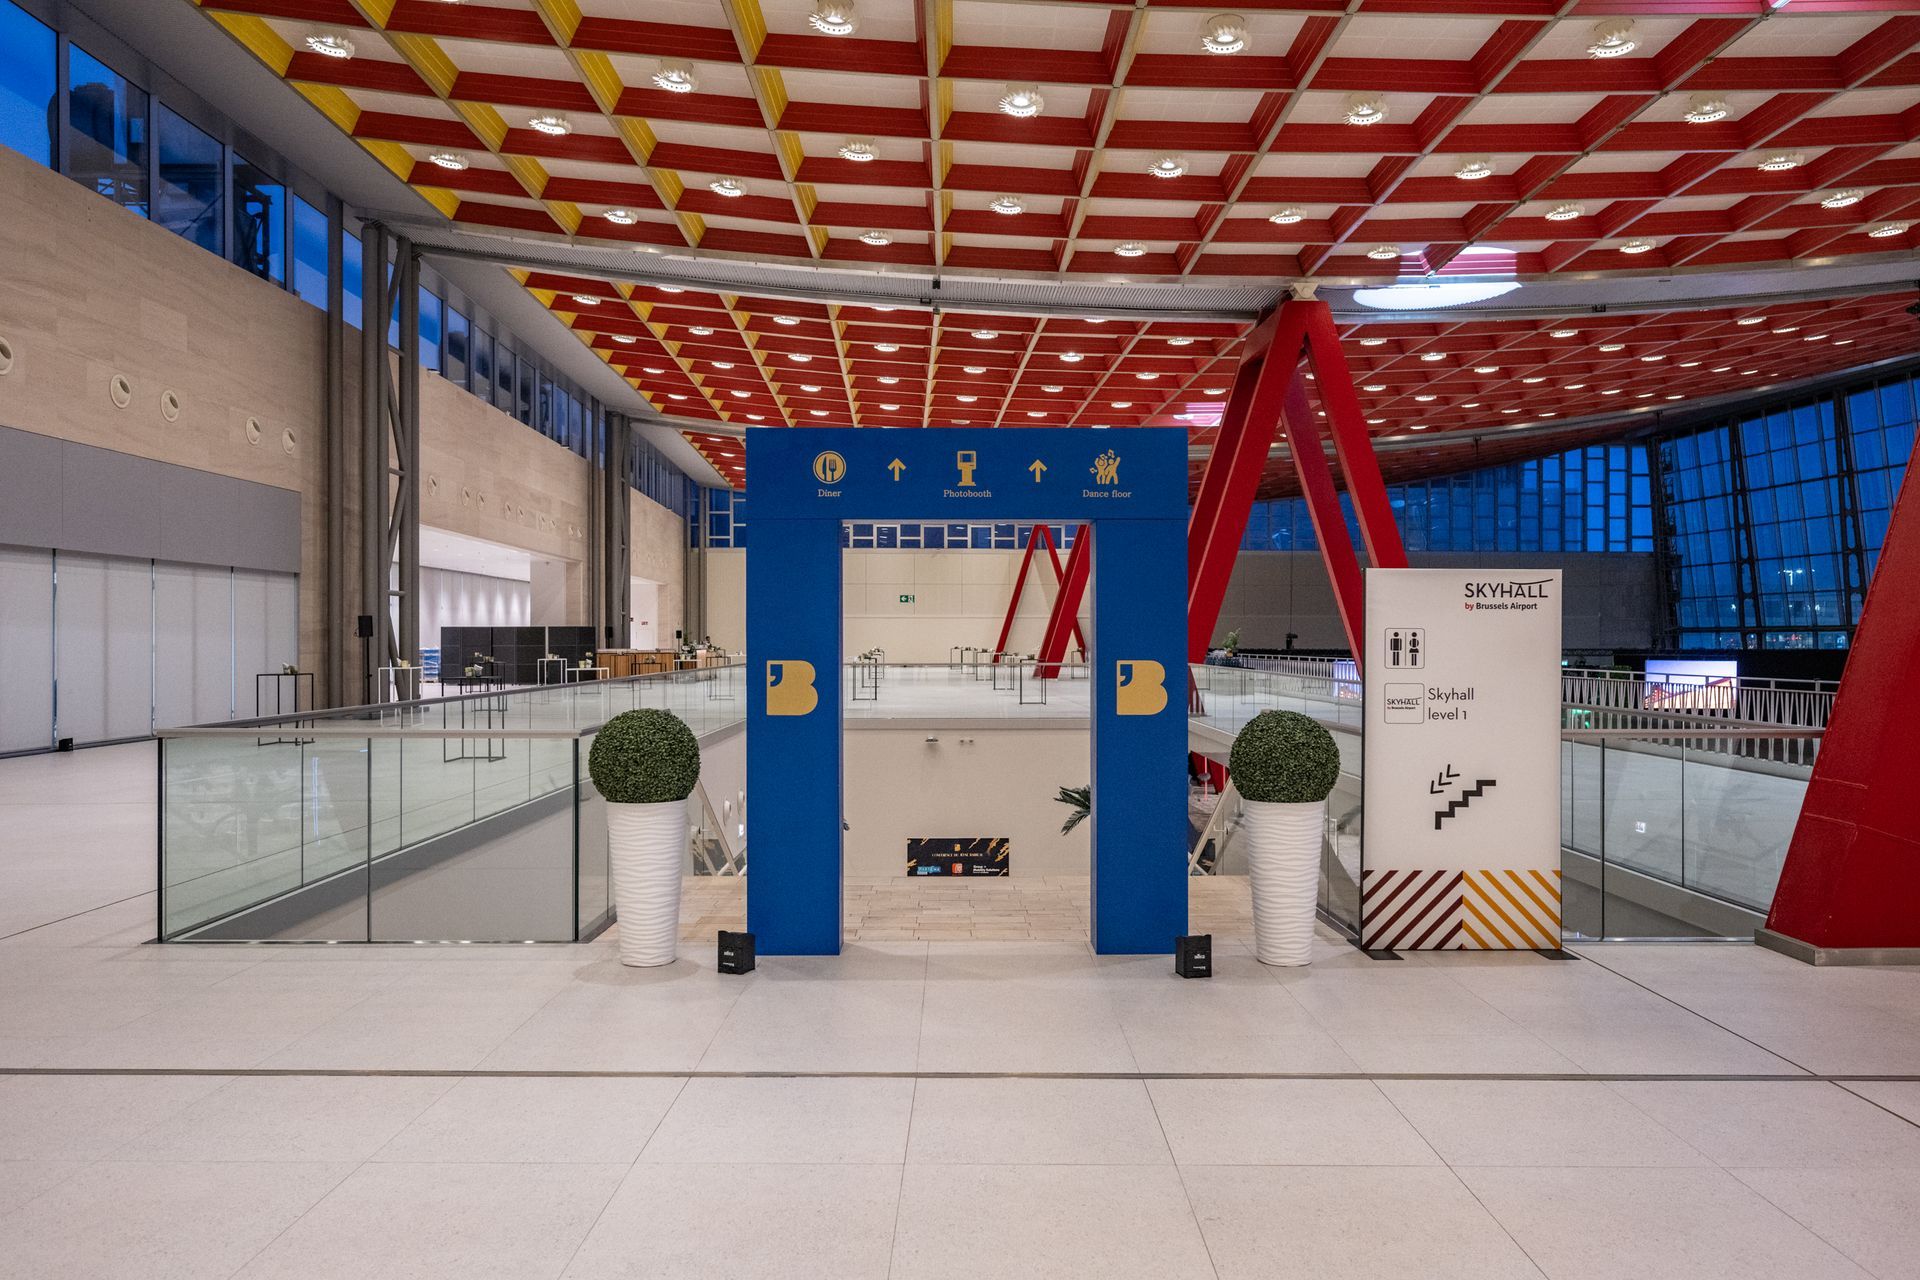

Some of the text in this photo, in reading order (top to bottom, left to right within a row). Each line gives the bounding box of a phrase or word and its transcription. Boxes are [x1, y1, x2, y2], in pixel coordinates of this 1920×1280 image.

[817, 489, 842, 498] Diner
[943, 489, 992, 498] Photobooth
[1082, 489, 1132, 498] Dance floor
[1464, 578, 1554, 598] SKYHALL
[1464, 602, 1538, 611] by Brussels Airport
[1428, 687, 1474, 703] Skyhall
[1387, 697, 1422, 706] SKYHALL
[1428, 707, 1467, 720] level 1
